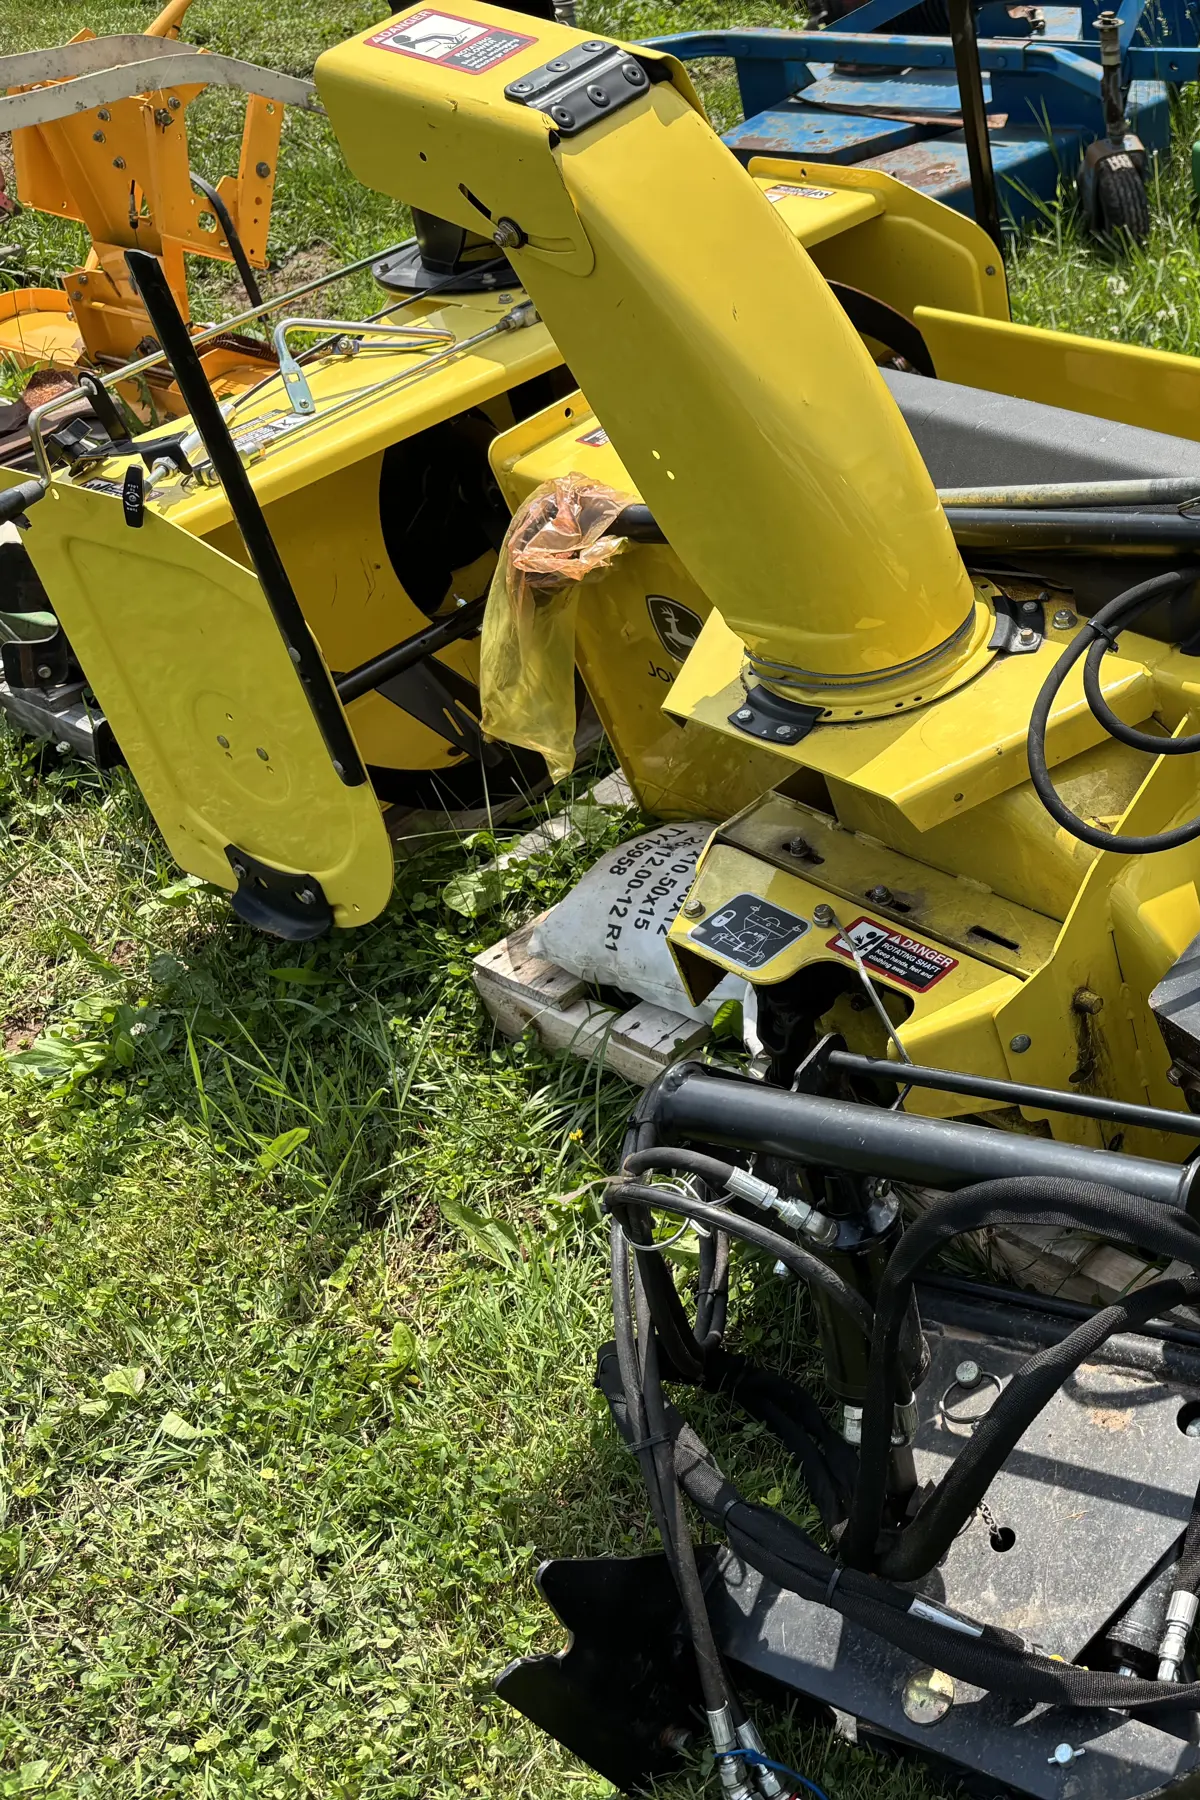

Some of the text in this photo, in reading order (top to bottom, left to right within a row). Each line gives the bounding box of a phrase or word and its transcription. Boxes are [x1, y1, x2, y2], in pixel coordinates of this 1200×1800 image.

[379, 11, 432, 38] DANGER
[454, 36, 492, 57] ROTATING
[463, 40, 497, 58] BLOWER
[609, 828, 688, 876] TY15958
[604, 923, 622, 952] R1
[868, 955, 908, 976] clothing away
[875, 949, 891, 959] Keep
[909, 965, 922, 974] feet
[881, 942, 941, 973] ROTATING SHAFT
[900, 938, 954, 969] DANGER
